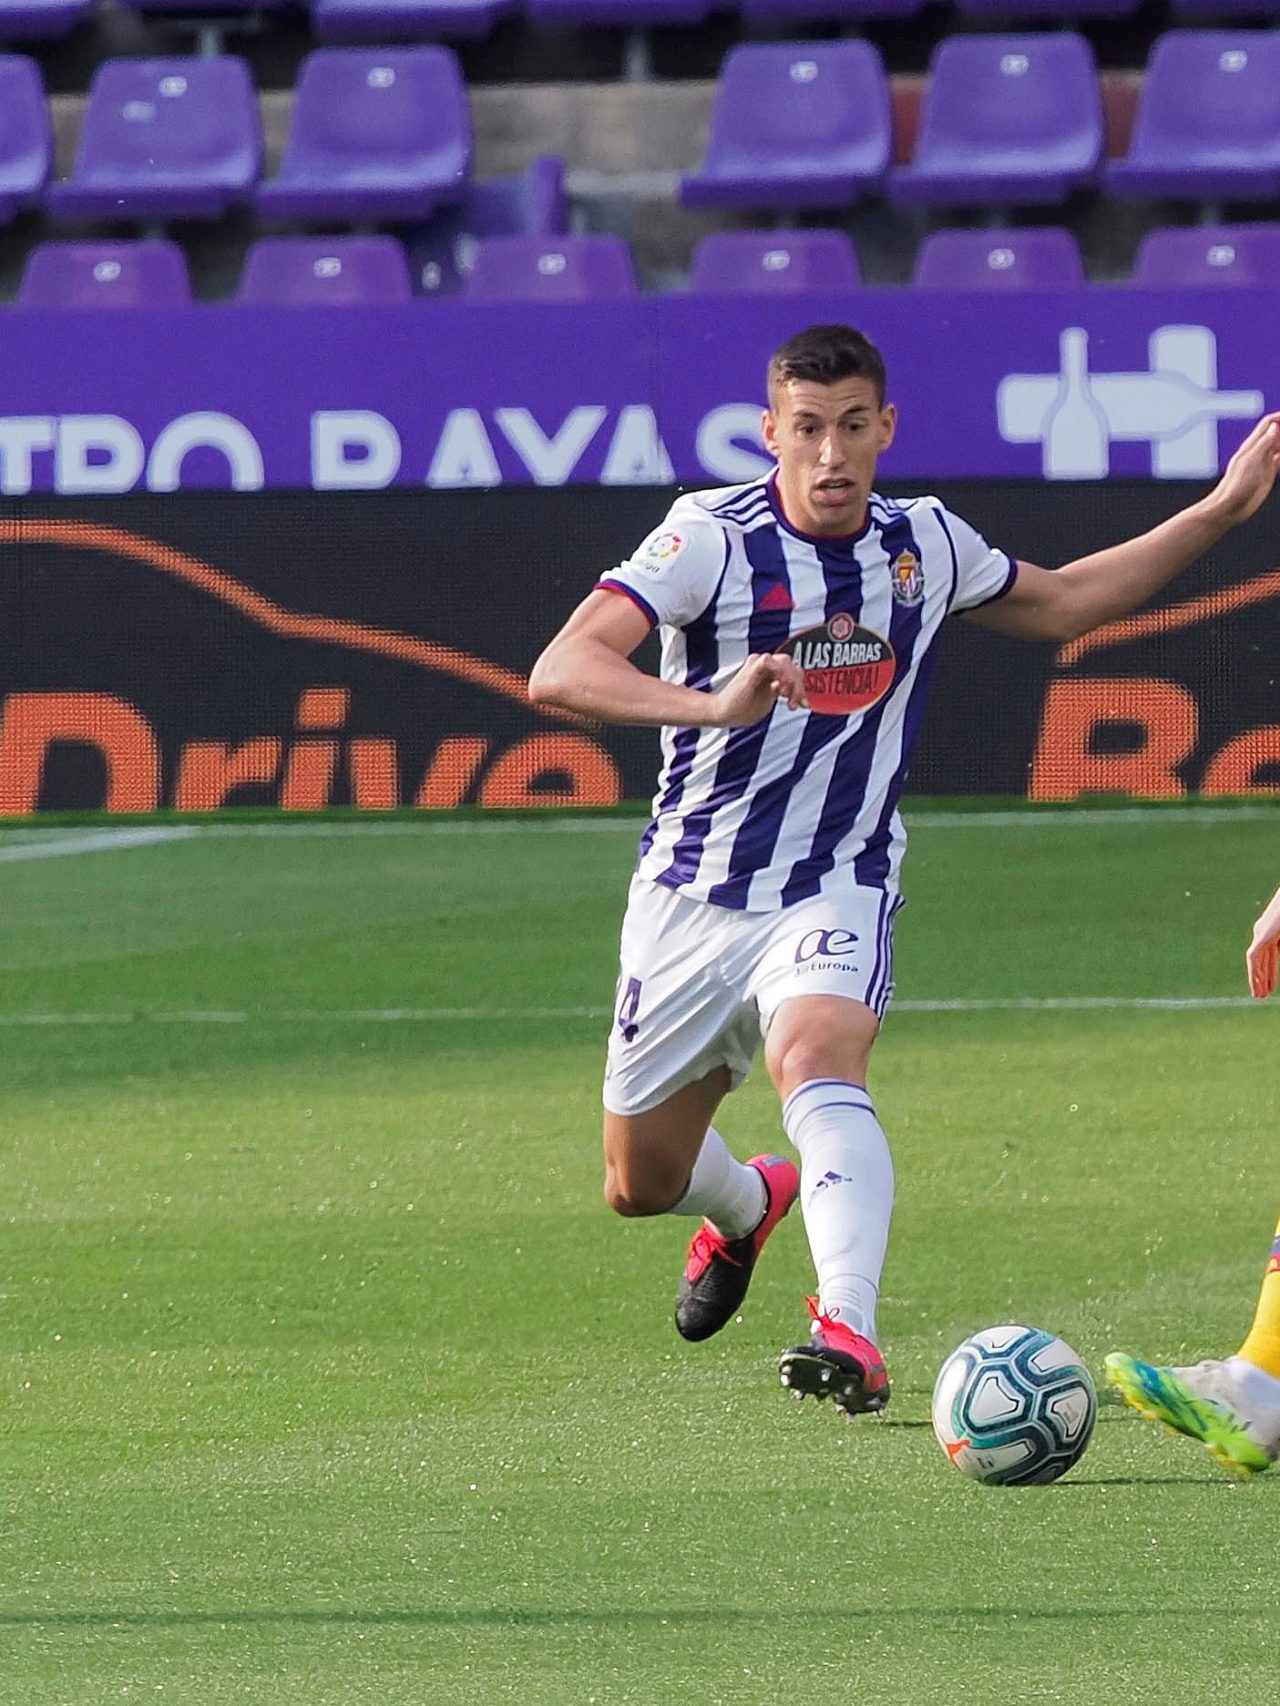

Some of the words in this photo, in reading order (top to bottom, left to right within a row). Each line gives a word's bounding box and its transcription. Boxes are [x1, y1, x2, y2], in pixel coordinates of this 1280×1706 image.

[792, 640, 803, 666] A
[803, 641, 831, 670] LAS
[831, 642, 882, 667] BARRAS
